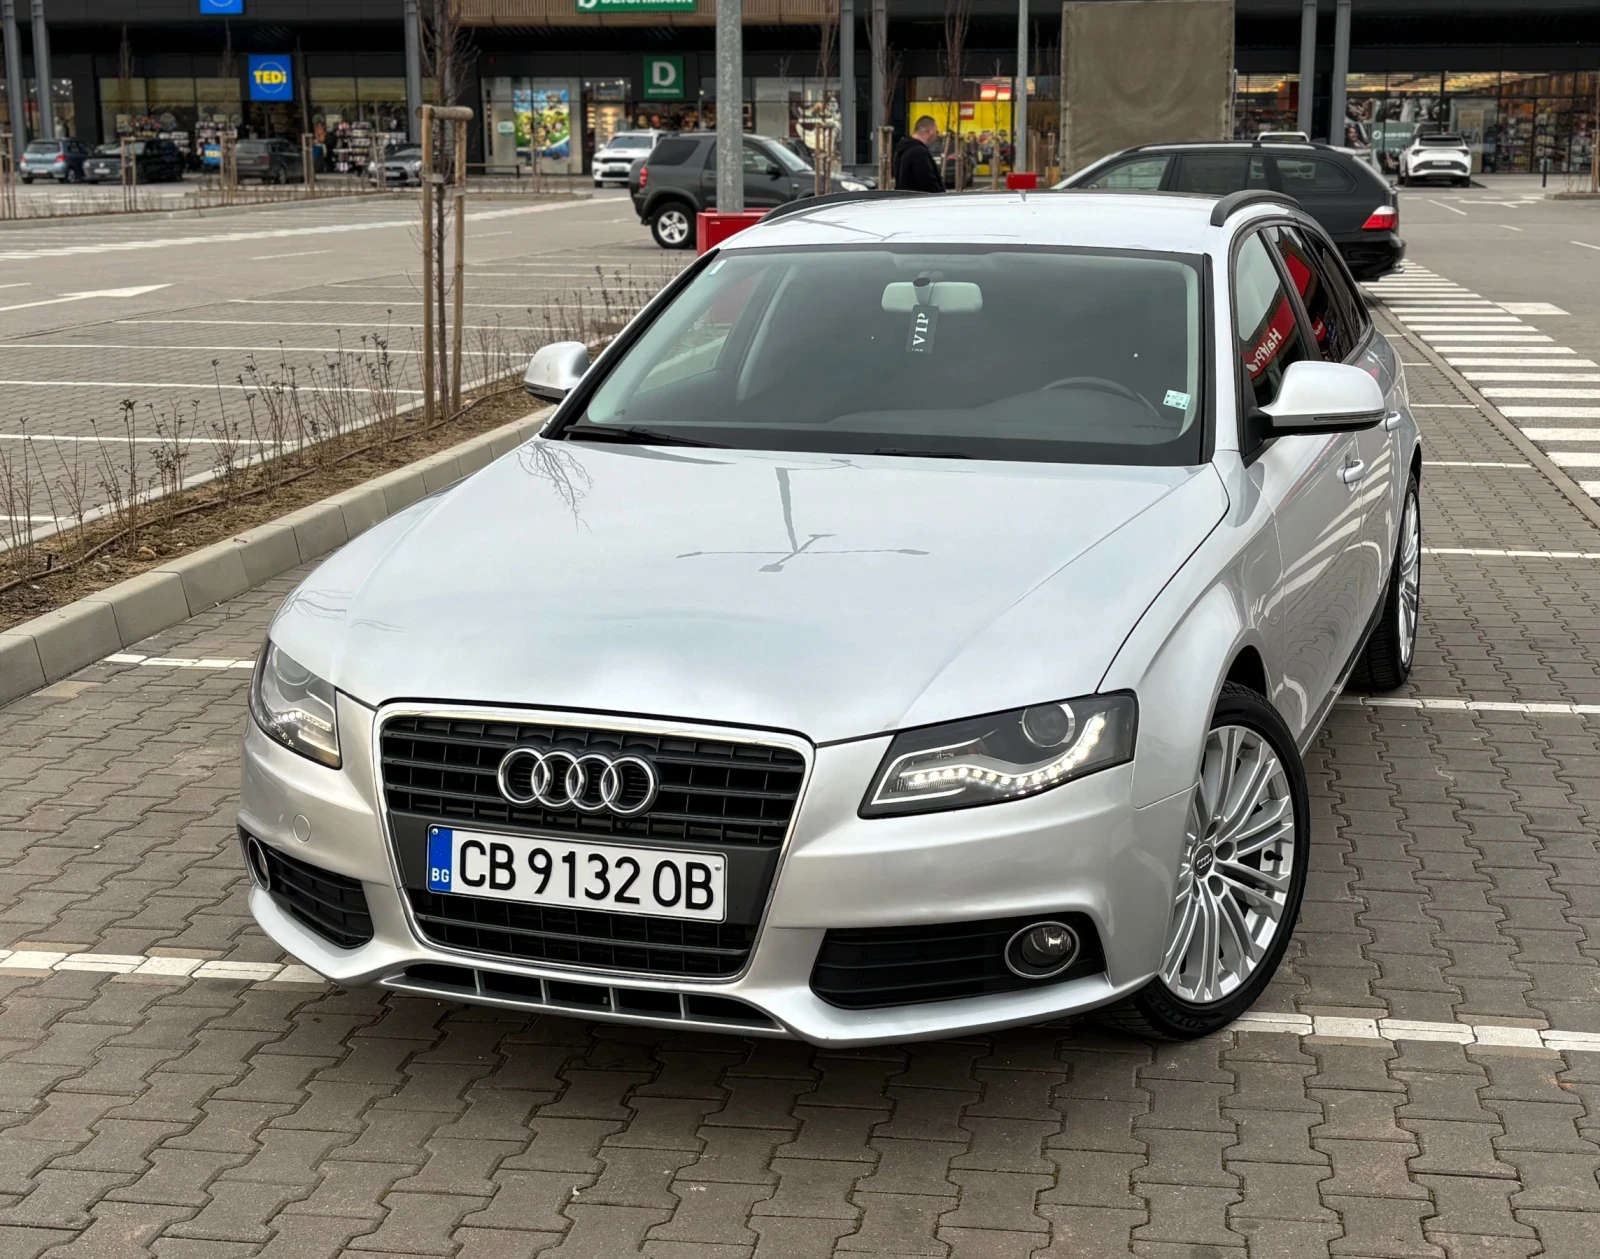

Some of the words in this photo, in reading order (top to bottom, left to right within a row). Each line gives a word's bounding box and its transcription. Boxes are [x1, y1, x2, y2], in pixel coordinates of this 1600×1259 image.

[253, 71, 287, 84] TEDi
[652, 61, 676, 87] D
[912, 312, 929, 346] VIP
[432, 867, 450, 883] BG
[459, 839, 516, 891] CB
[527, 847, 641, 905] 9132
[652, 859, 714, 911] OB
